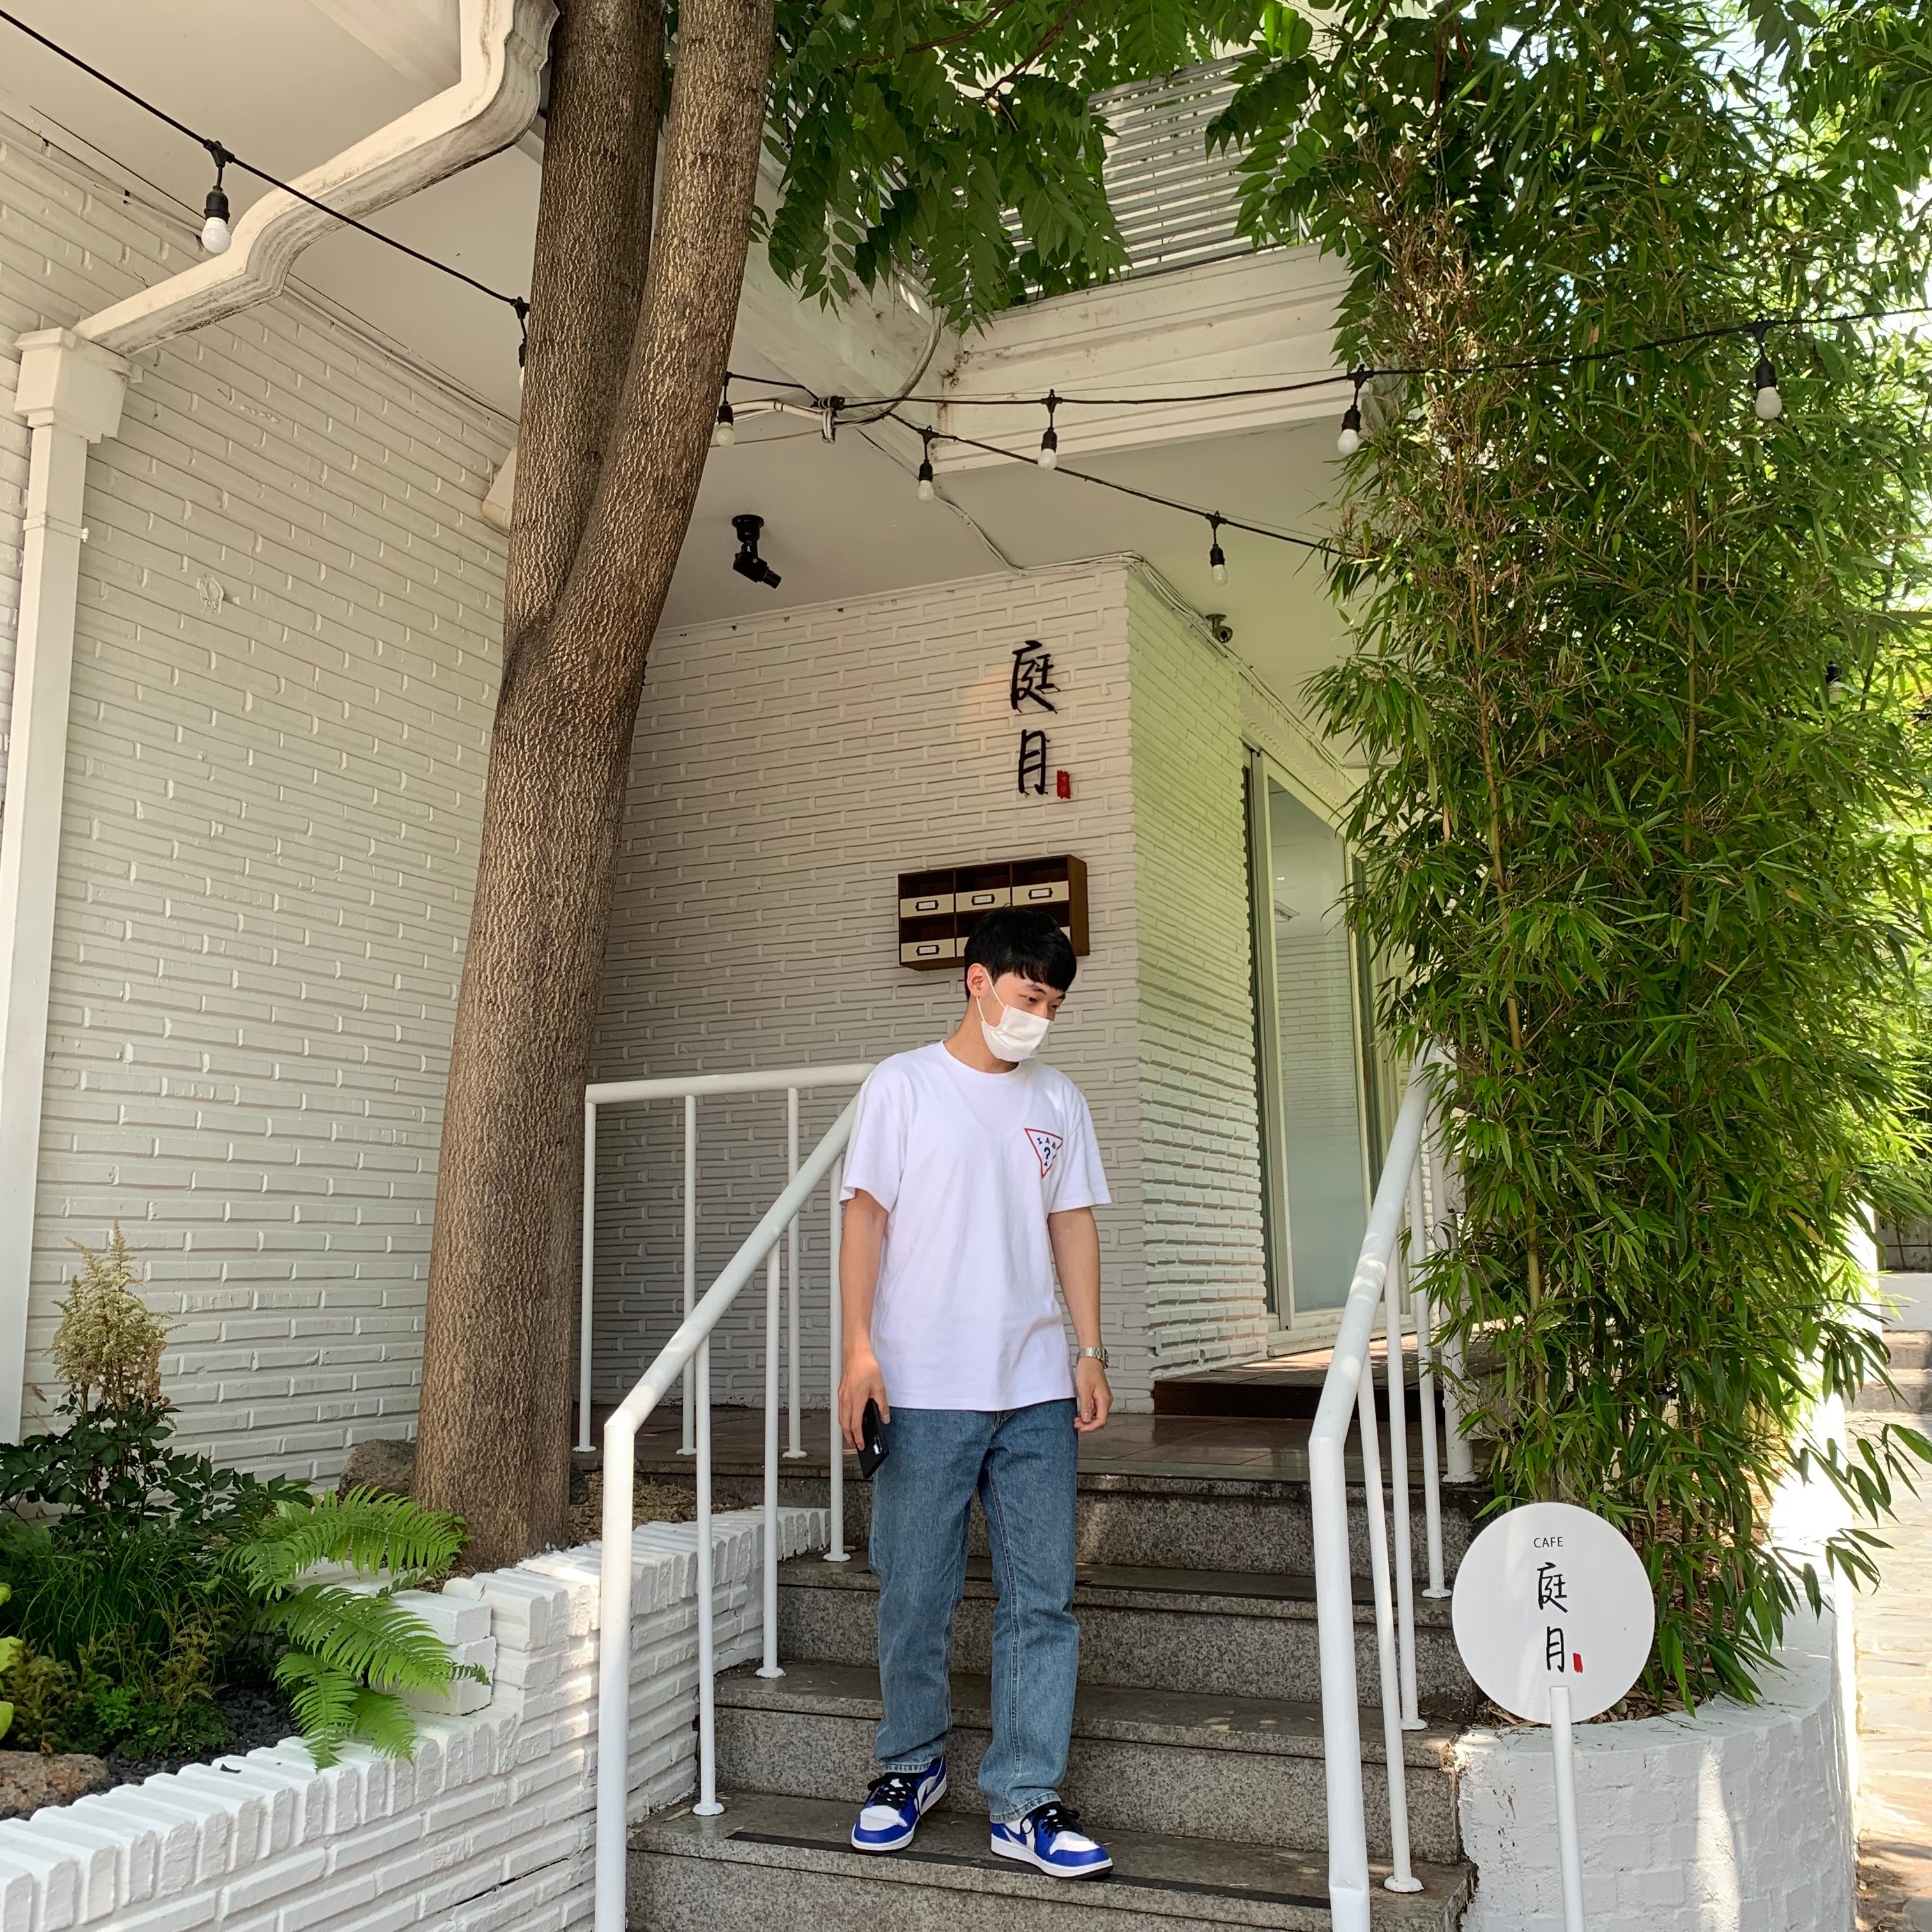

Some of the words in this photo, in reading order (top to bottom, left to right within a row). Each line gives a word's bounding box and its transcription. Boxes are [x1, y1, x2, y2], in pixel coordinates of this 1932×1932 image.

[1010, 640, 1058, 795] 庭月
[1533, 1536, 1564, 1548] CAFE
[1537, 1561, 1568, 1673] 庭月
